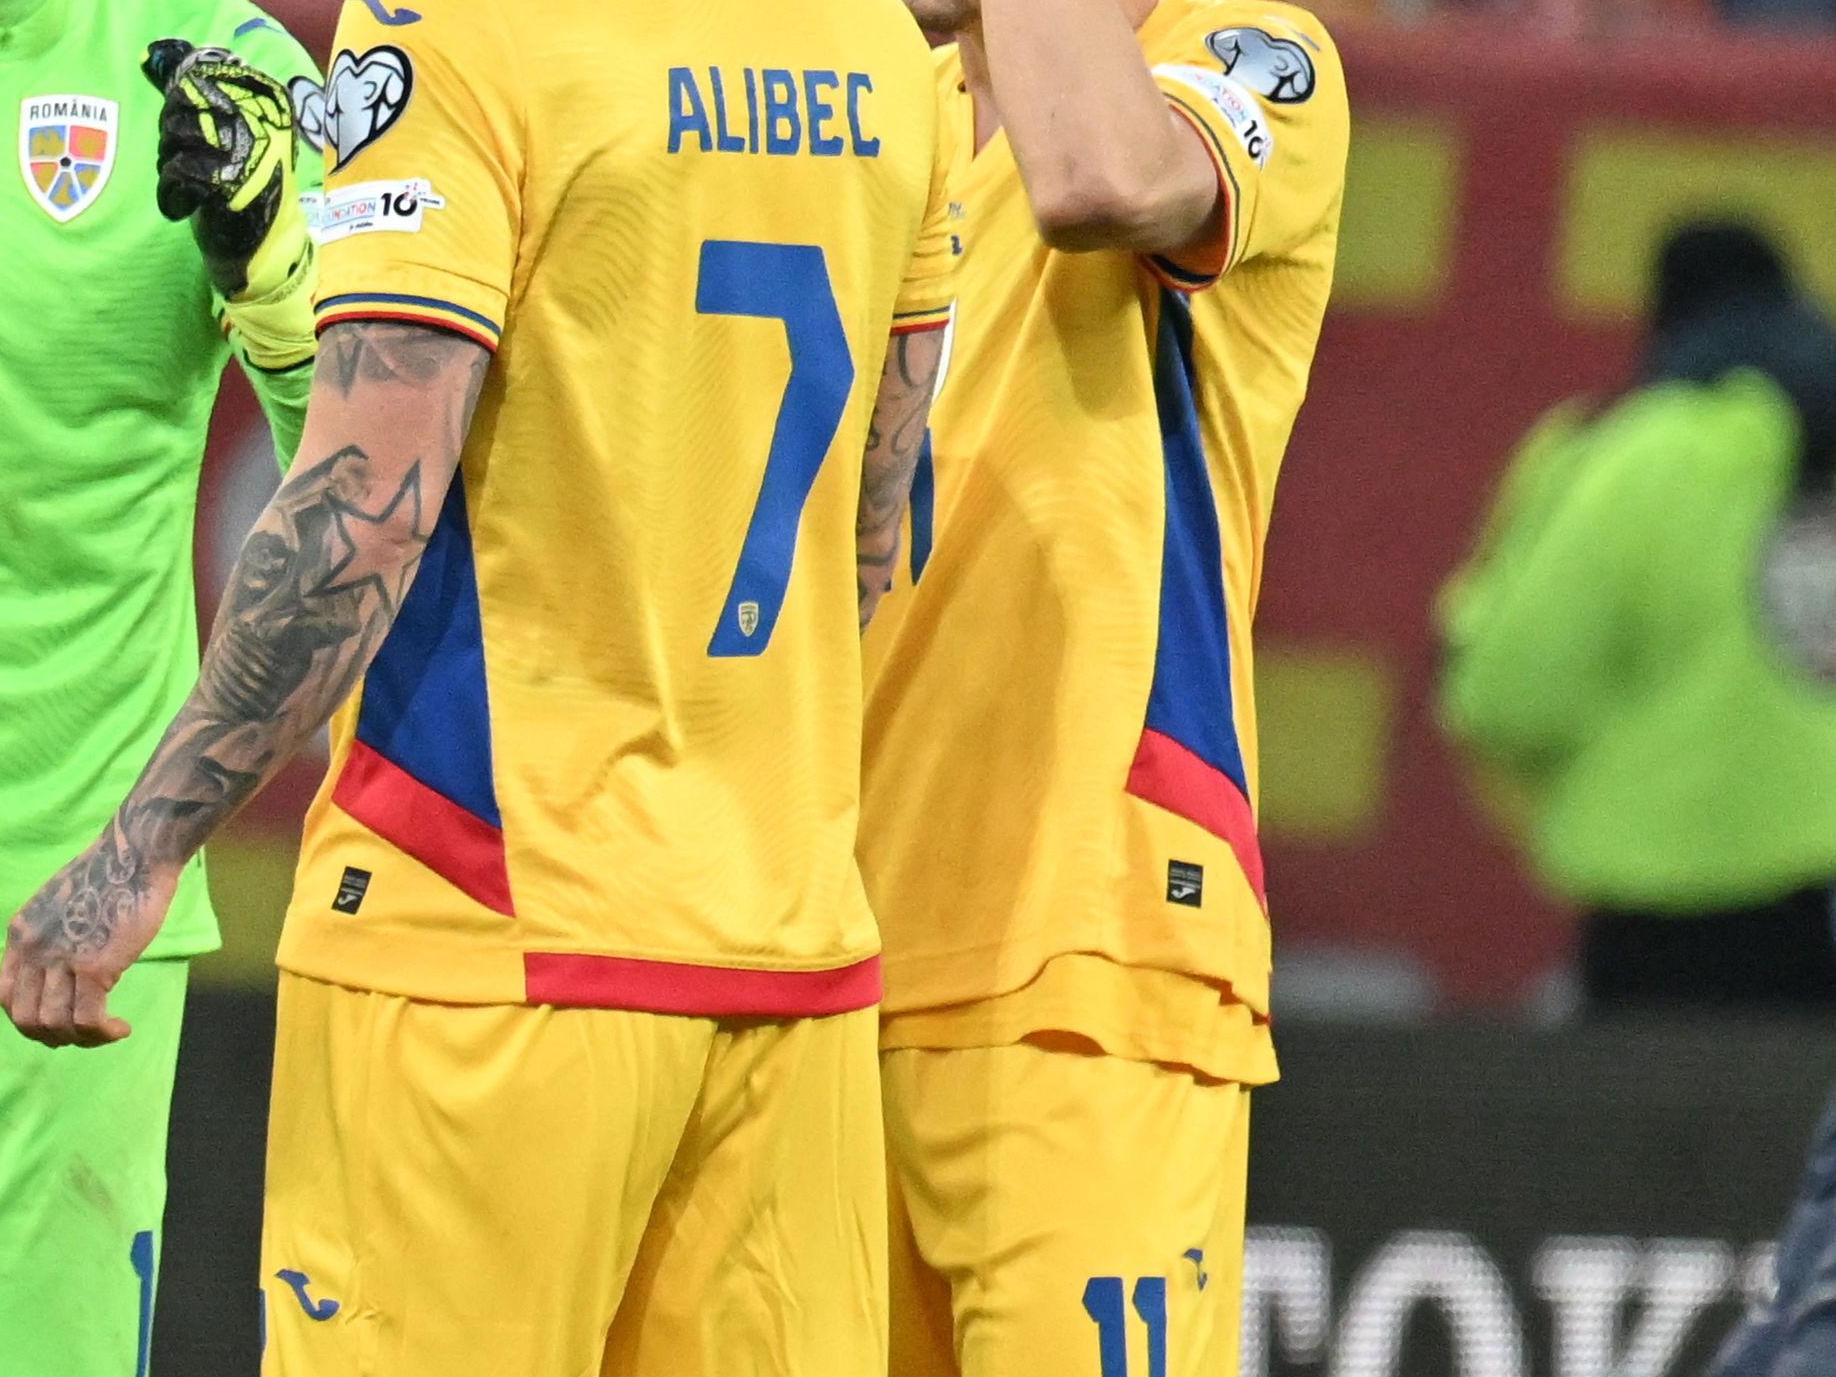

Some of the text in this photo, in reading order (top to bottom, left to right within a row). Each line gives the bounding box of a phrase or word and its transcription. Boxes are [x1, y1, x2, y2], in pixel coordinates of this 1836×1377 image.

[29, 98, 108, 123] ROMÂNIA
[666, 65, 881, 158] ALIBEC
[694, 239, 855, 658] 7
